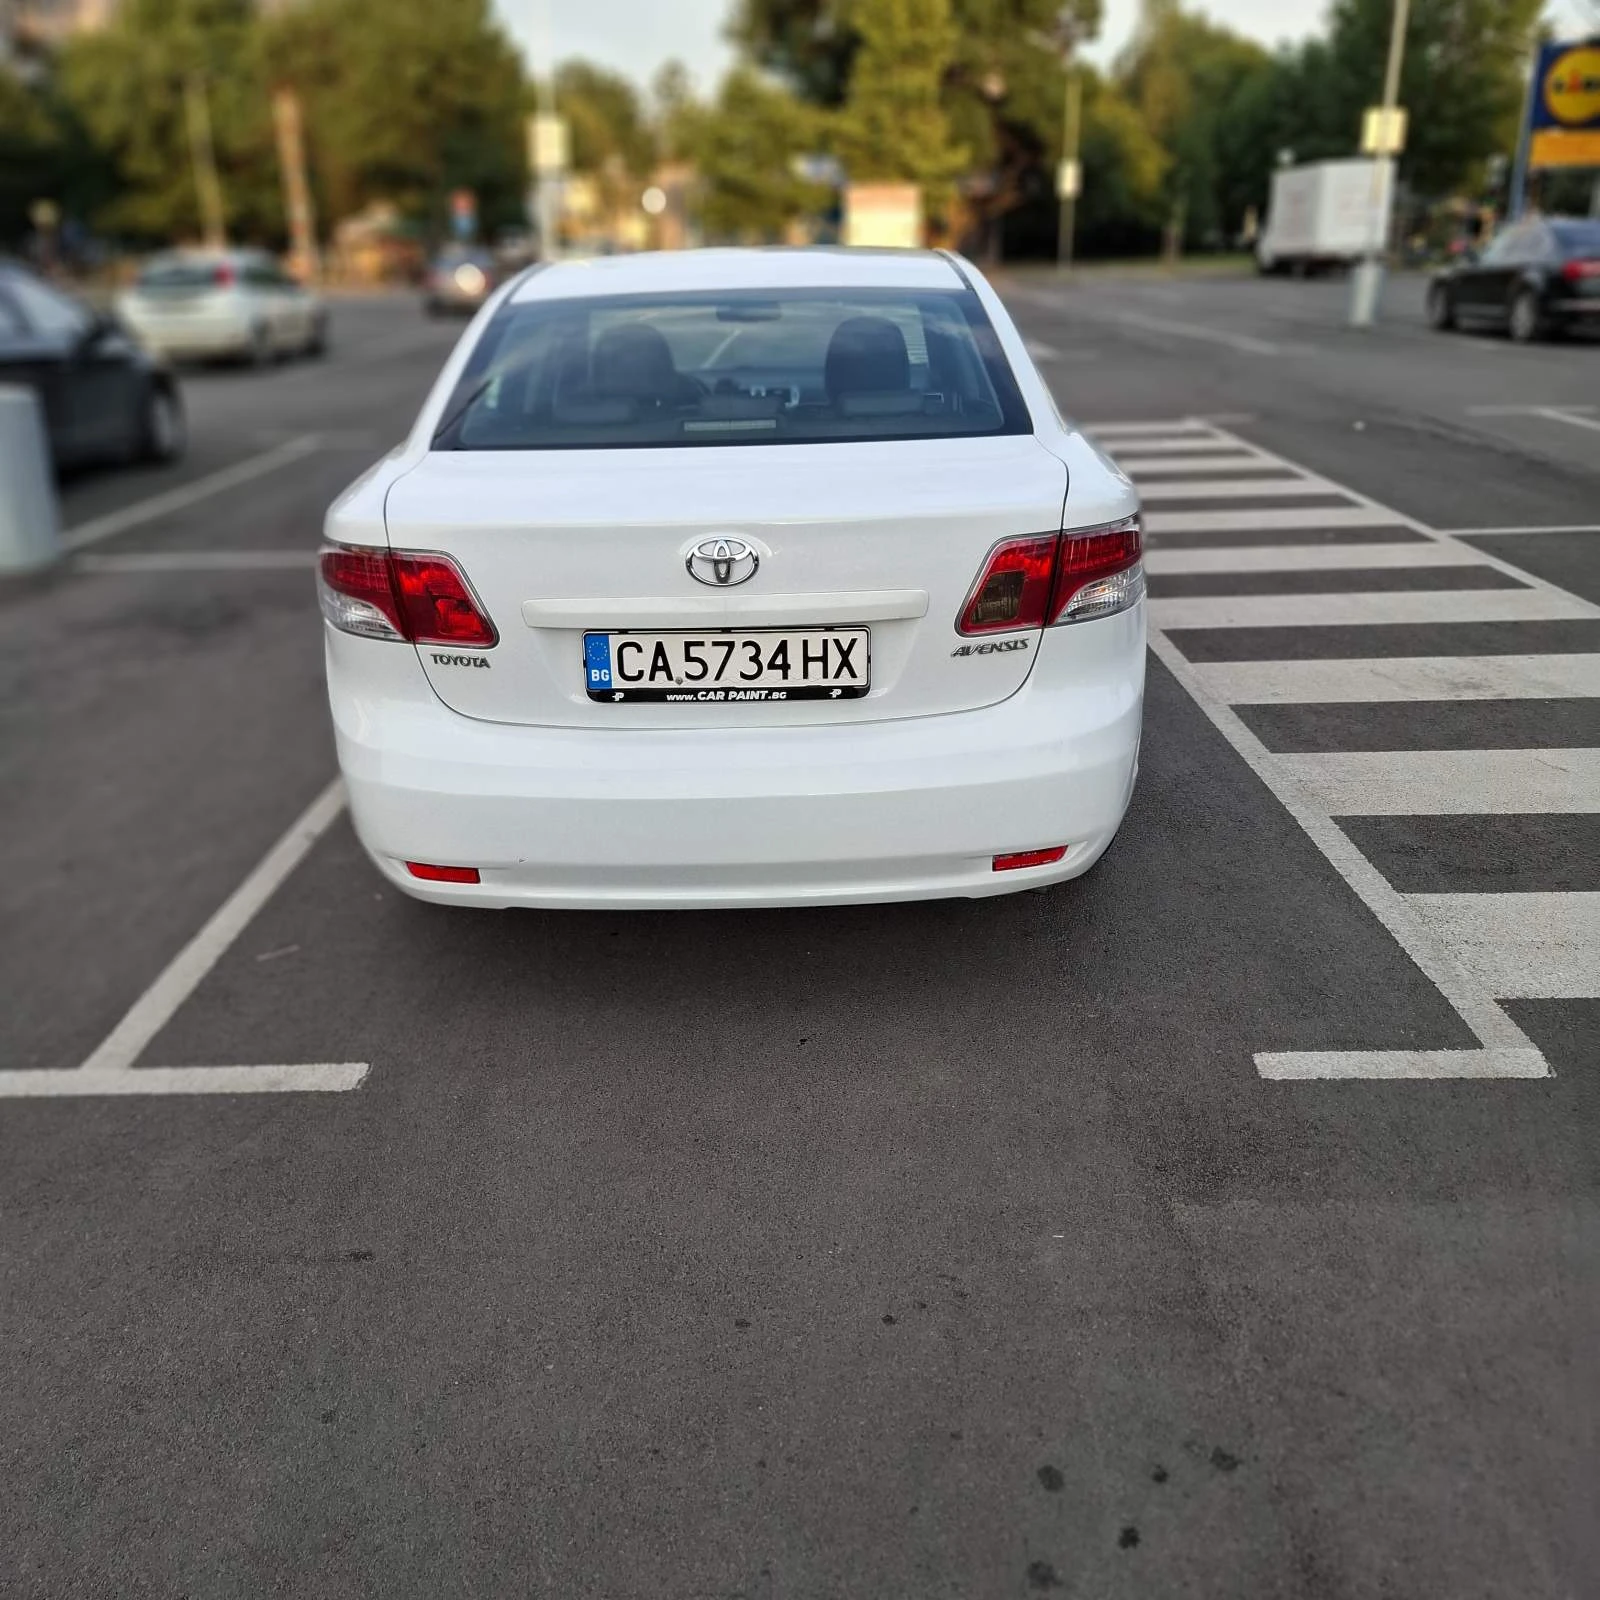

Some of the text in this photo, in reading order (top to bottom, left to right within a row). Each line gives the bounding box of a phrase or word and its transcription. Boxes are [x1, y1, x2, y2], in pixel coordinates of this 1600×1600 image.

[951, 639, 1029, 657] AVENSIS
[430, 653, 491, 669] TOYOTA
[591, 669, 610, 682] BG
